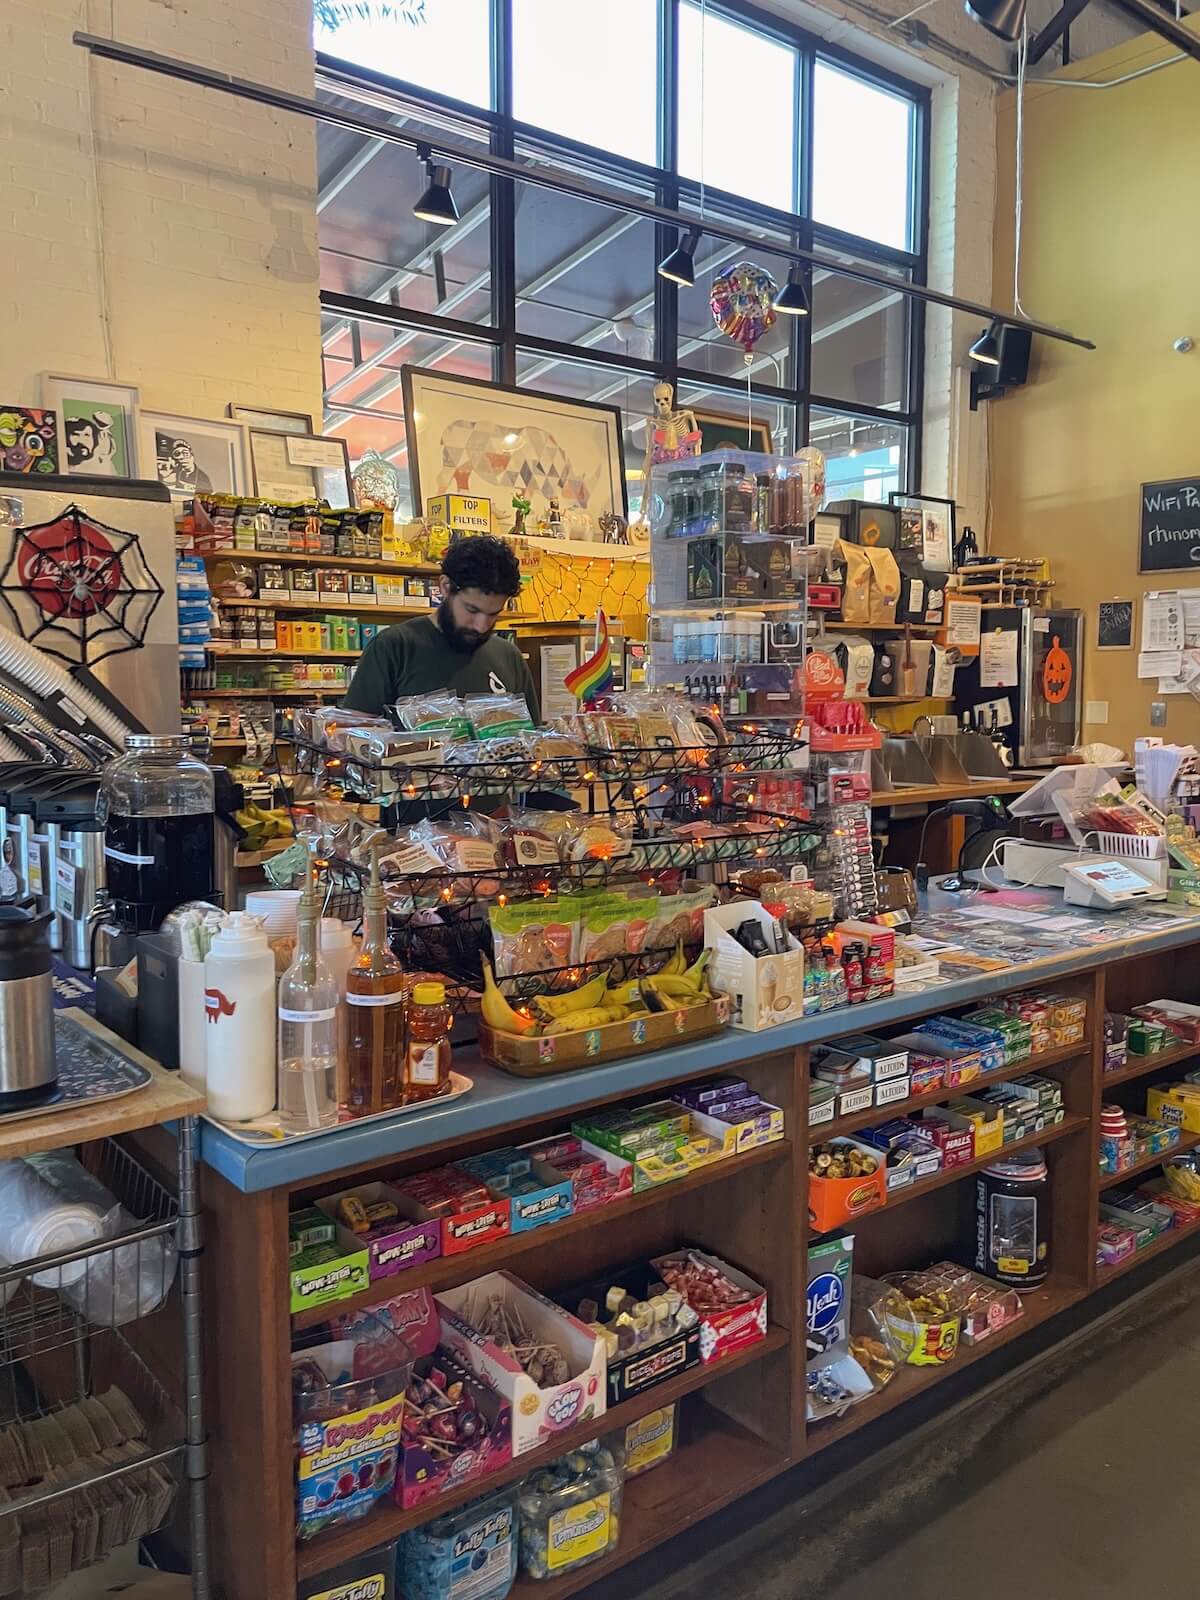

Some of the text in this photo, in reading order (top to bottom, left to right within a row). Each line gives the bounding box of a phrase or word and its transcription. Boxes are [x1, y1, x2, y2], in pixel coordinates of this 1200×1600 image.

[431, 503, 442, 516] TOP
[462, 499, 479, 511] TOP
[453, 515, 488, 526] FILTERS
[181, 706, 203, 714] dvil
[880, 1060, 905, 1074] ALTOIDS
[810, 1106, 832, 1121] LTOIDS
[1161, 1103, 1183, 1116] Juicy
[1162, 1113, 1183, 1124] Fruit
[905, 1121, 934, 1142] ALLS
[946, 1135, 972, 1150] HALLS
[976, 1180, 986, 1269] Tootsie Roll
[807, 1279, 841, 1333] York
[555, 1402, 578, 1423] POP
[311, 1449, 350, 1471] Limited
[350, 1439, 384, 1455] Edition
[454, 1512, 509, 1558] Laffy Taffy
